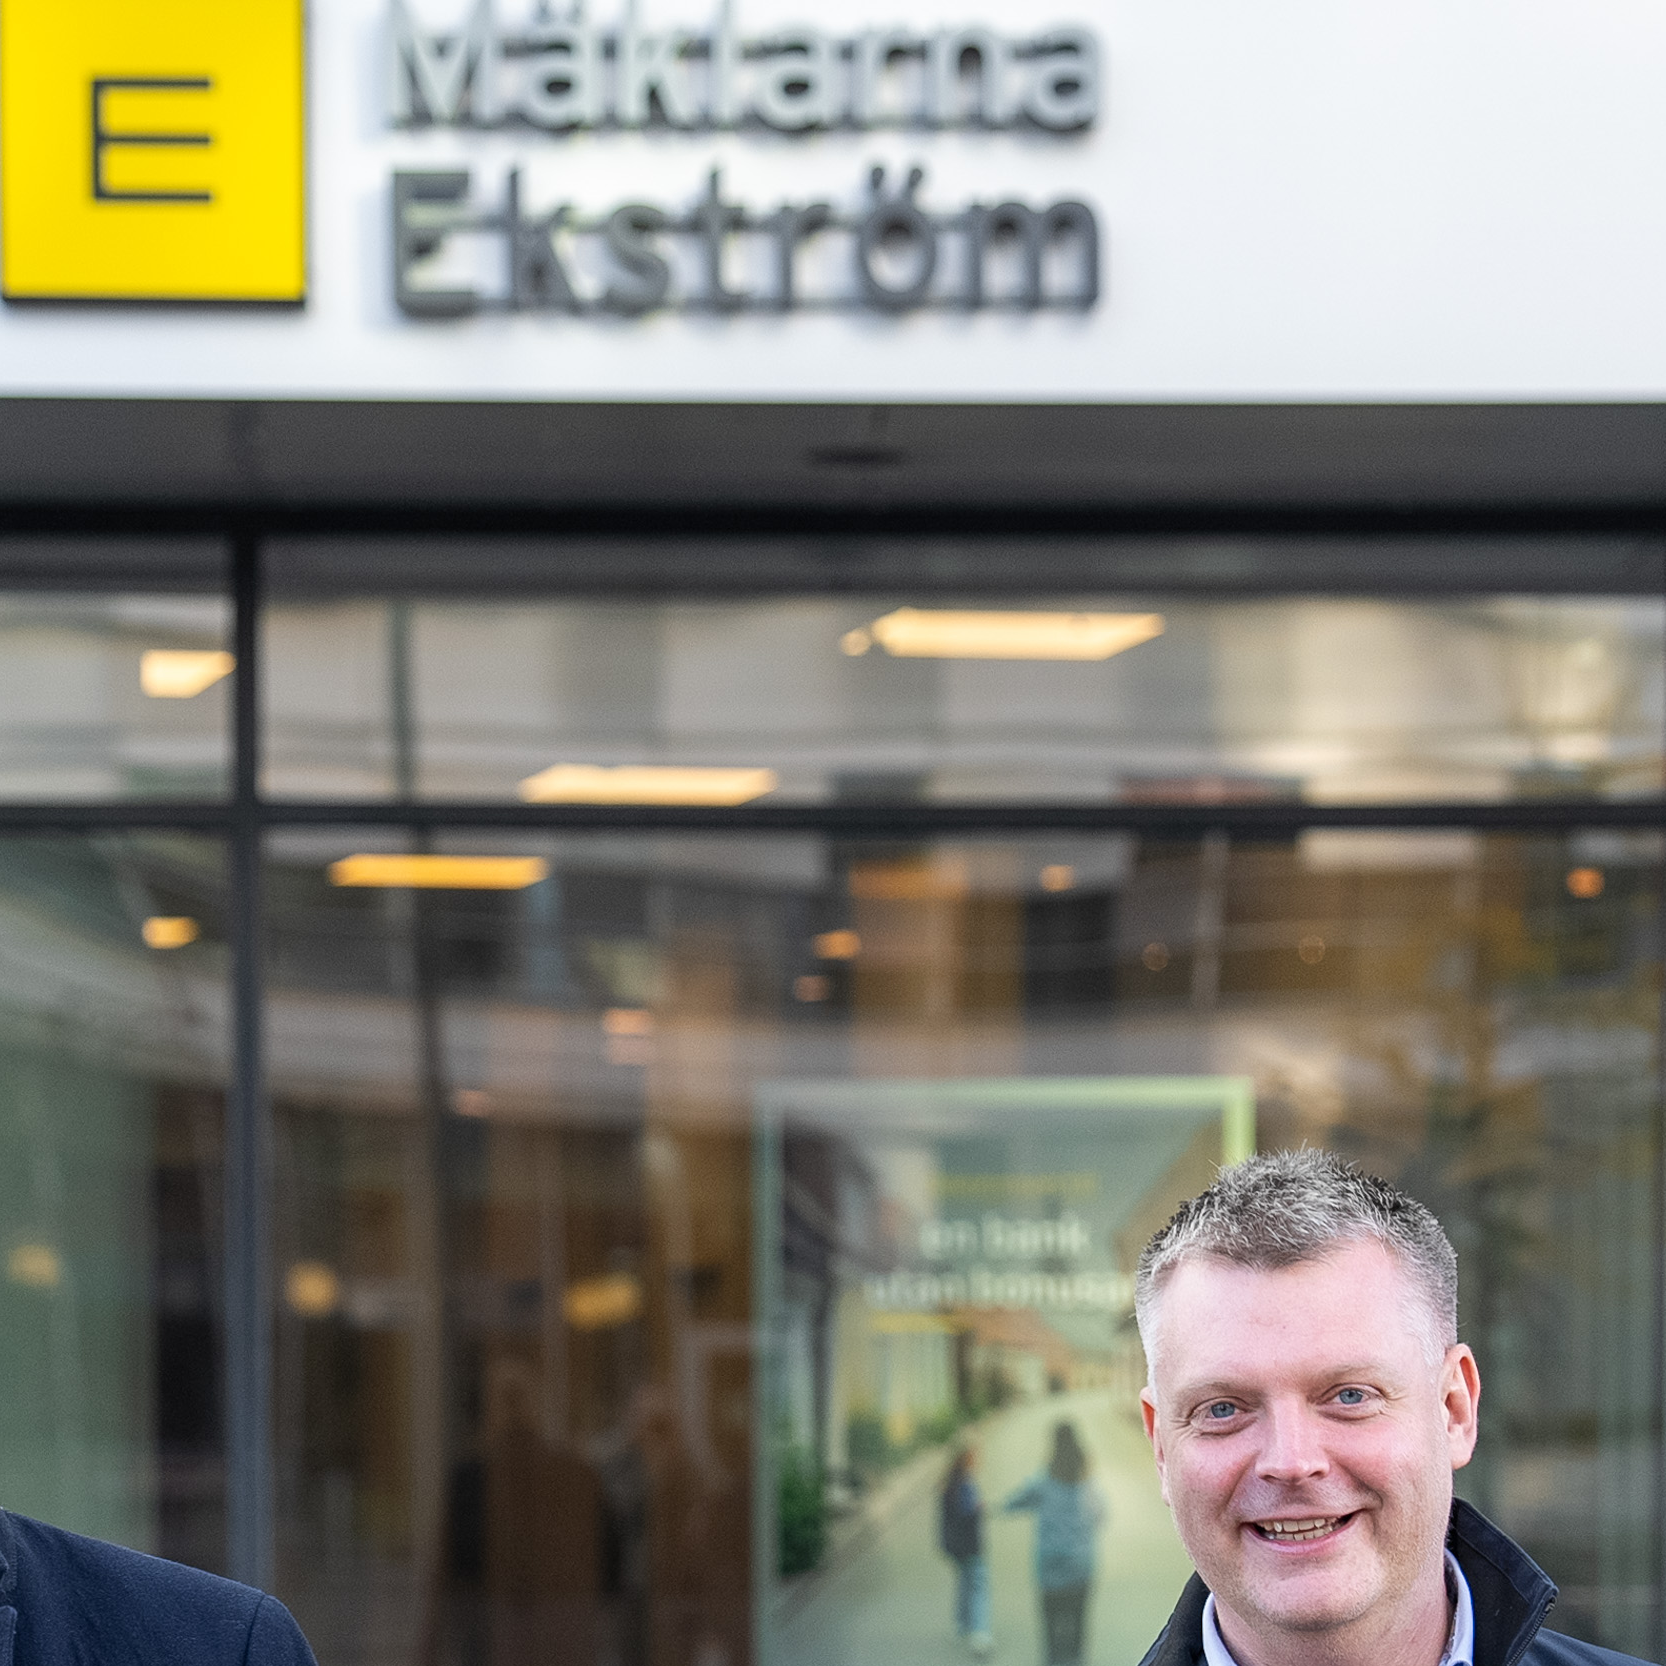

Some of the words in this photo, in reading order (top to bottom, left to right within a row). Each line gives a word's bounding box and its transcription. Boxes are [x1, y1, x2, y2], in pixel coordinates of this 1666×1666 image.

[385, 0, 1103, 134] Mäklarna
[89, 75, 213, 204] E
[389, 163, 1103, 318] Ekström
